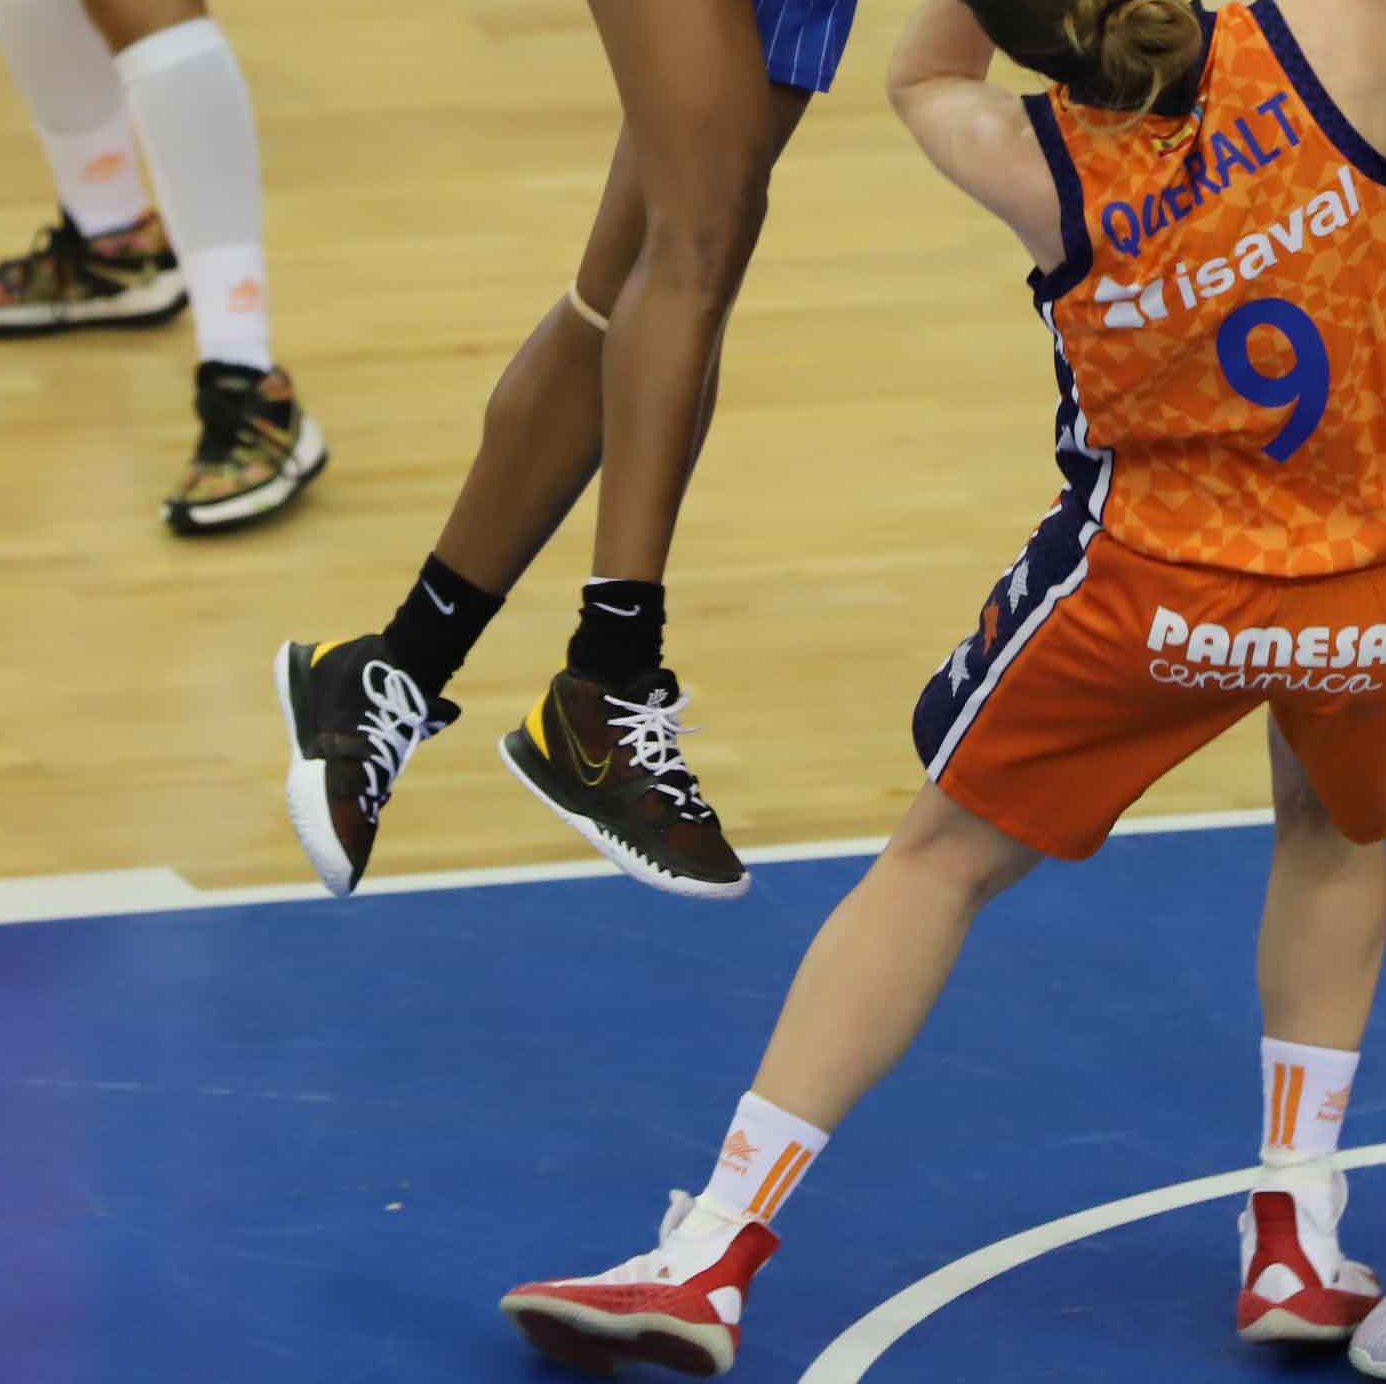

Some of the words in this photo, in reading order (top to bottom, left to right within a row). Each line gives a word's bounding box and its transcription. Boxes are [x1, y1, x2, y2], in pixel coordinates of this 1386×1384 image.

[1100, 91, 1302, 258] QUERALT
[1174, 164, 1360, 311] isaval
[1216, 296, 1331, 463] 9
